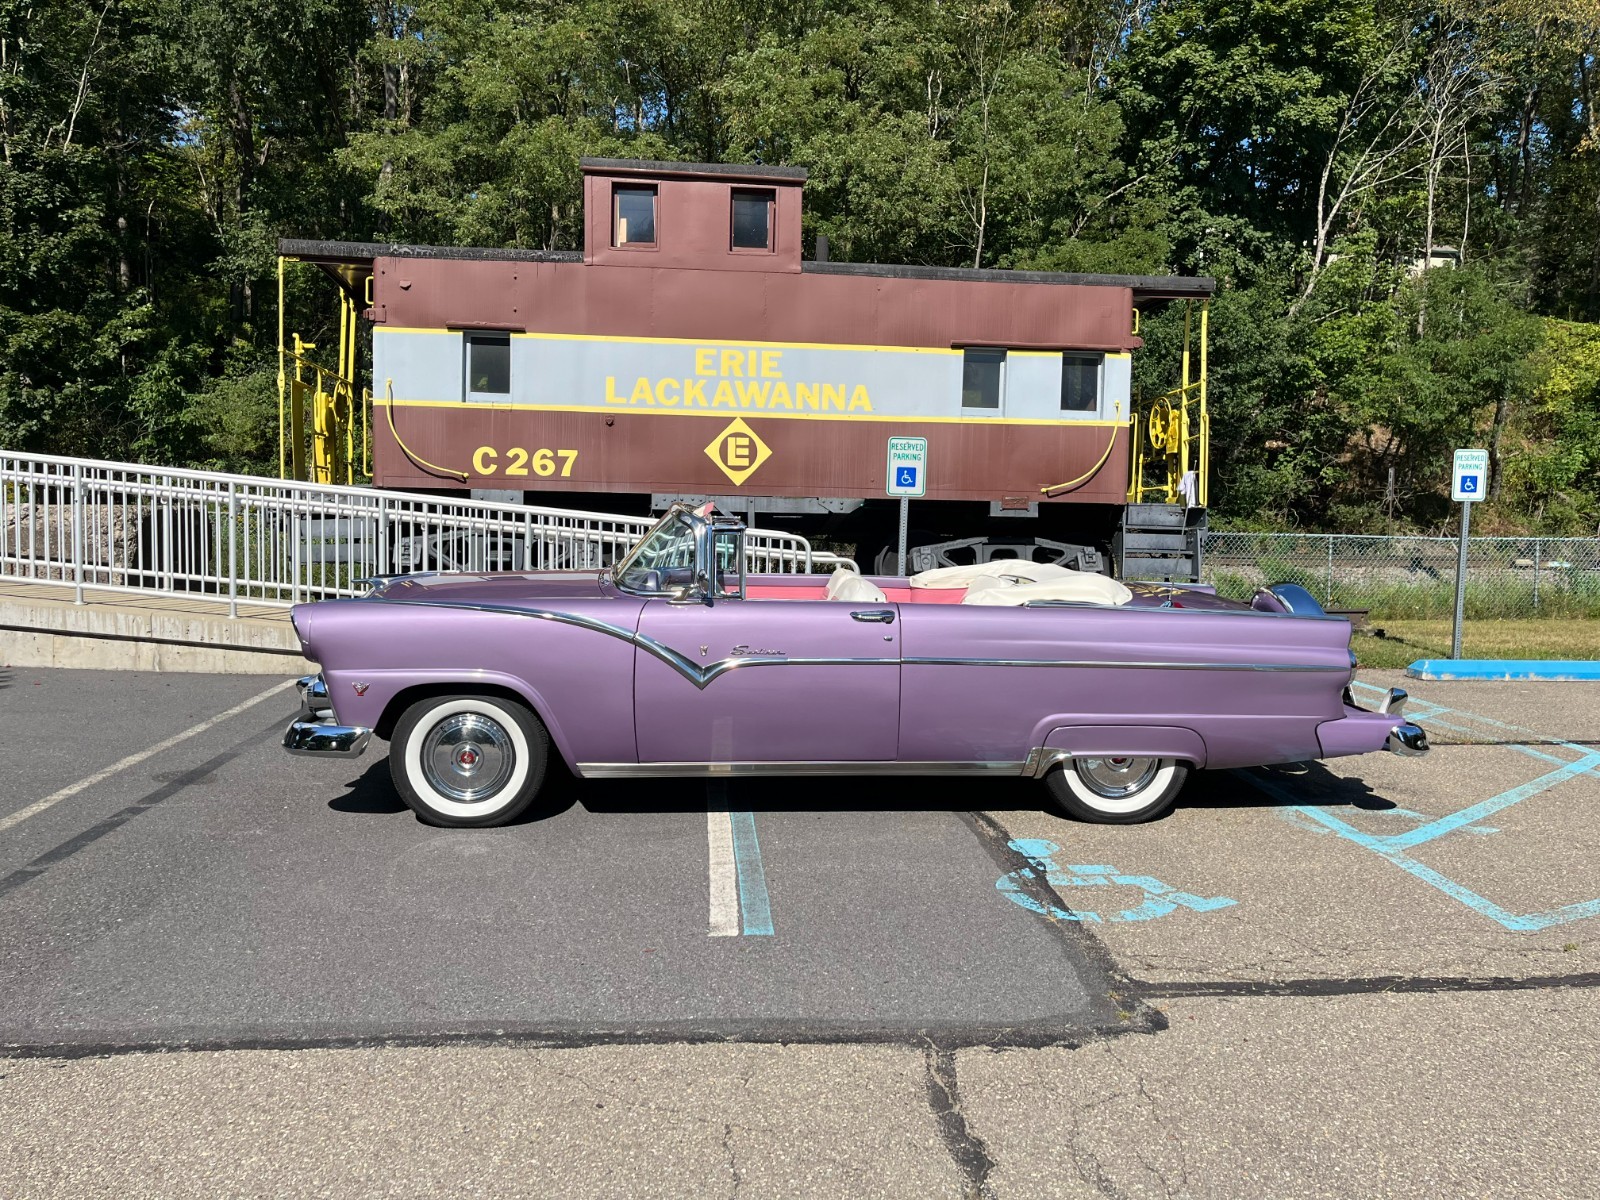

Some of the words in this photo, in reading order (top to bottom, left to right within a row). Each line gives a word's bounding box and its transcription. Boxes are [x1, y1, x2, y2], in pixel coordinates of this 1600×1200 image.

[695, 348, 783, 378] ERIE
[605, 376, 873, 412] LACKAWANNA
[891, 442, 924, 451] RESERVED
[472, 446, 498, 475] C
[505, 447, 578, 477] 267
[893, 453, 922, 461] PARKING
[1456, 454, 1485, 462] RESERVED
[1458, 463, 1483, 471] PARKING
